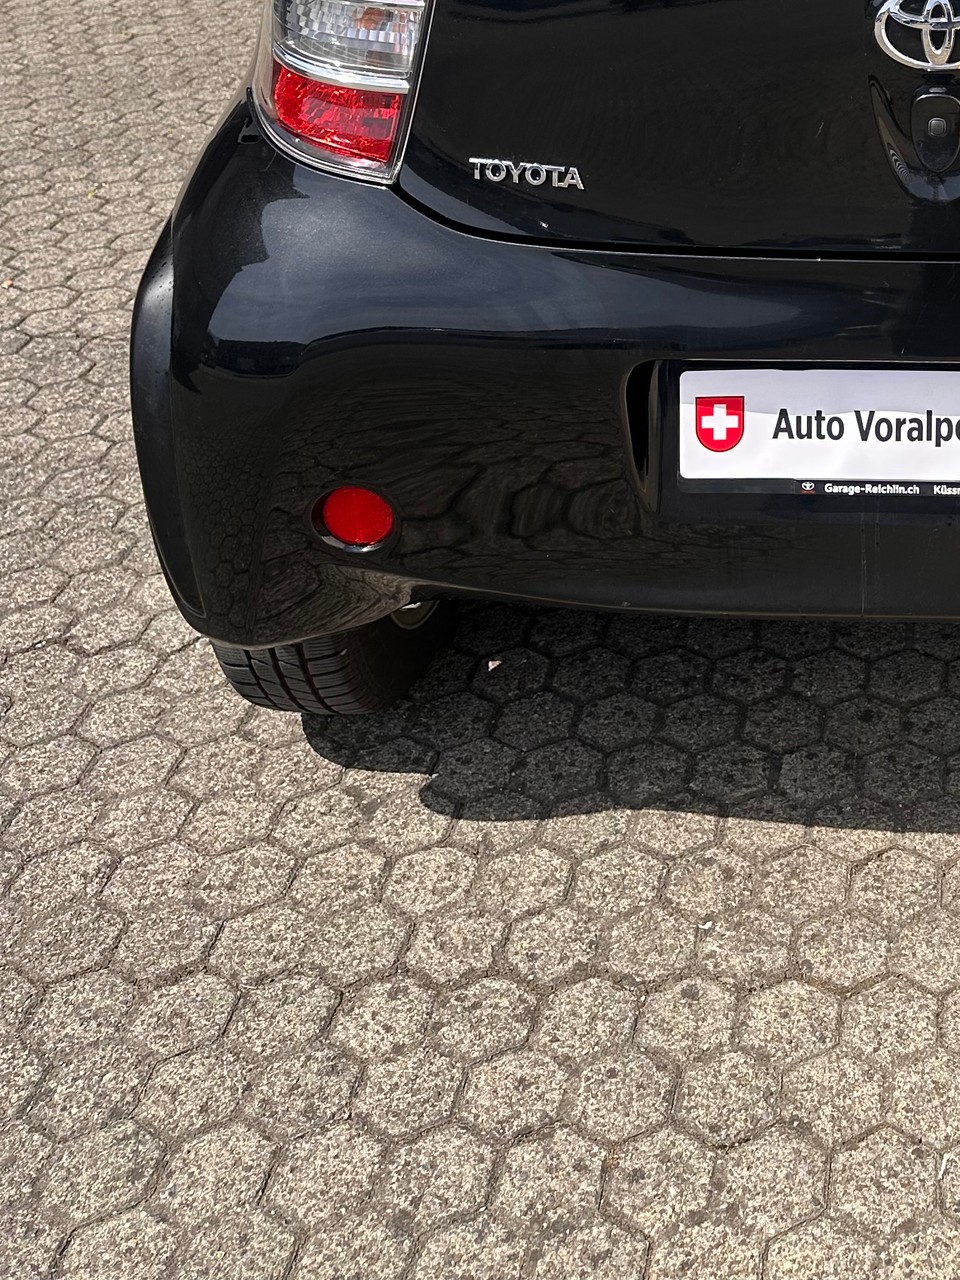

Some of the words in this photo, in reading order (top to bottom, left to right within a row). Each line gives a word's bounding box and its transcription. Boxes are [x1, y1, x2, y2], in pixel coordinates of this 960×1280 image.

[468, 157, 585, 190] TOYOTA
[772, 408, 845, 440] Auto
[824, 483, 920, 495] Garage-Reichlin.ch
